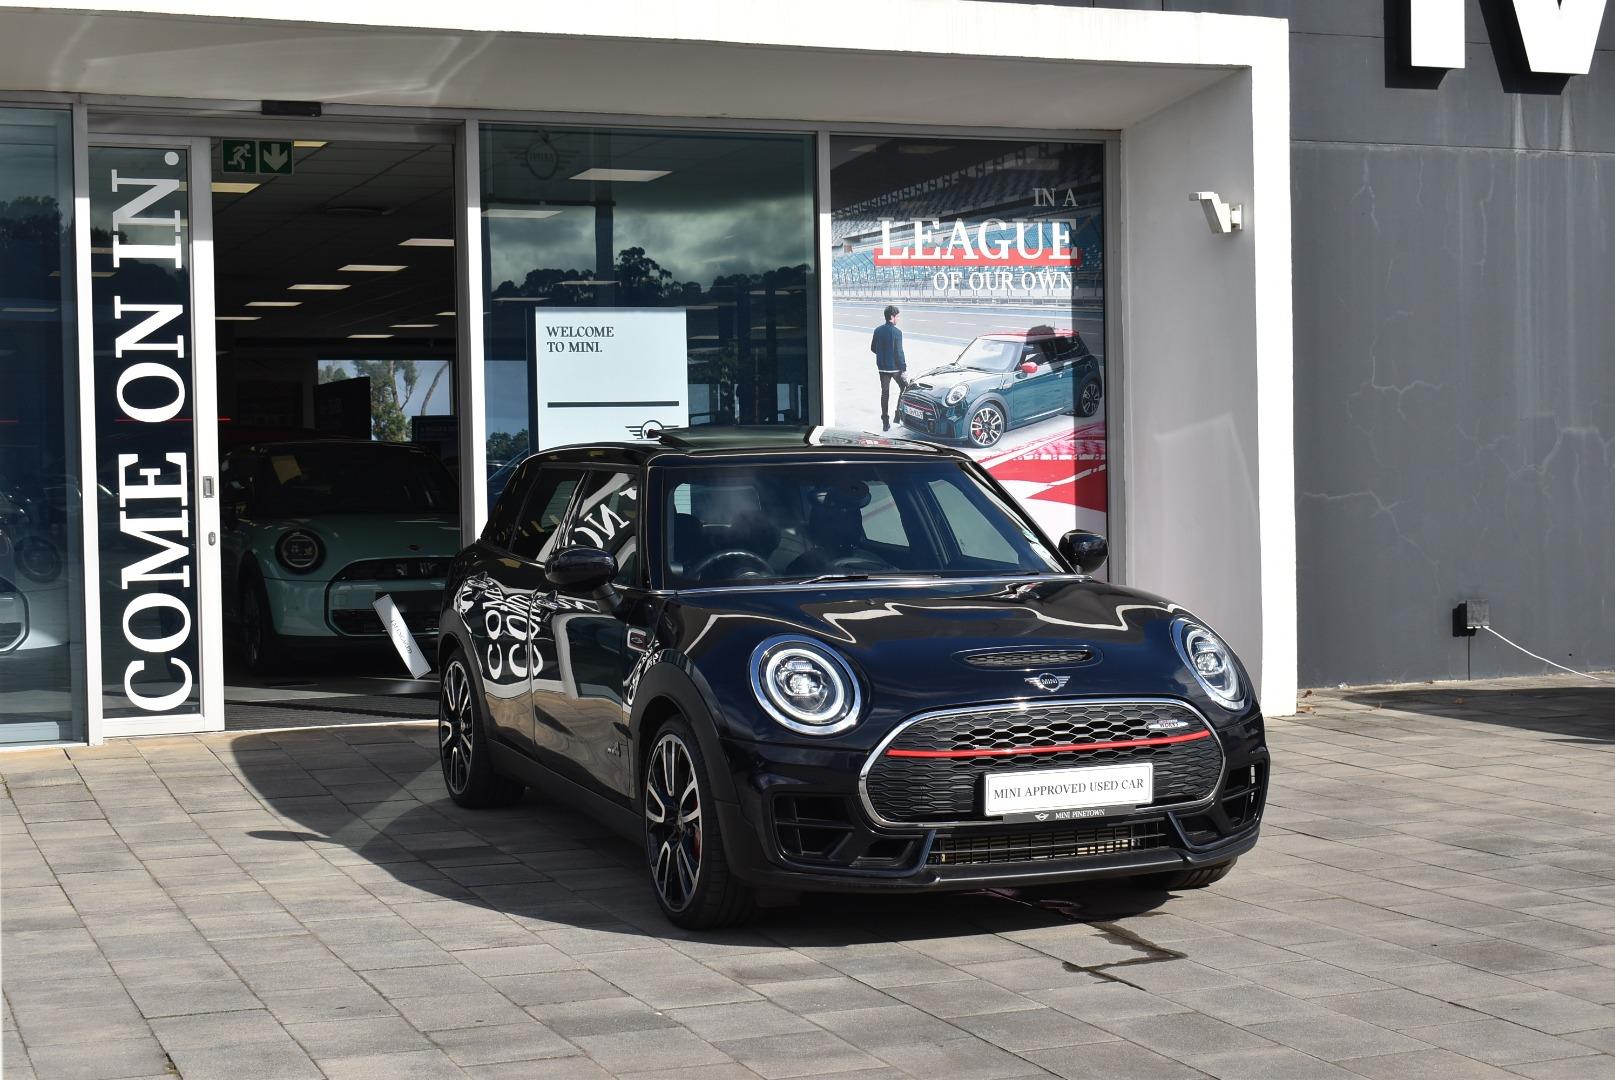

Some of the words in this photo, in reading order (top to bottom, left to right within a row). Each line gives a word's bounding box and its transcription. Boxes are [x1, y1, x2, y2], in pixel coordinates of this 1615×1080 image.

[1032, 188, 1056, 207] IN
[1063, 188, 1079, 207] A
[111, 151, 183, 269] IN.
[877, 217, 1078, 260] LEAGUE
[933, 272, 963, 291] OF
[969, 272, 1016, 291] OUR
[546, 326, 615, 338] WELCOME
[547, 341, 565, 353] TO
[568, 341, 603, 353] MINI.
[114, 296, 186, 423] ON
[118, 452, 193, 711] COME
[994, 787, 1021, 800] MINI
[1025, 783, 1087, 797] APPROVED
[1090, 780, 1119, 792] USED
[1121, 778, 1145, 789] CAR
[1055, 811, 1071, 820] MINI
[1072, 809, 1106, 818] PINETOWN
